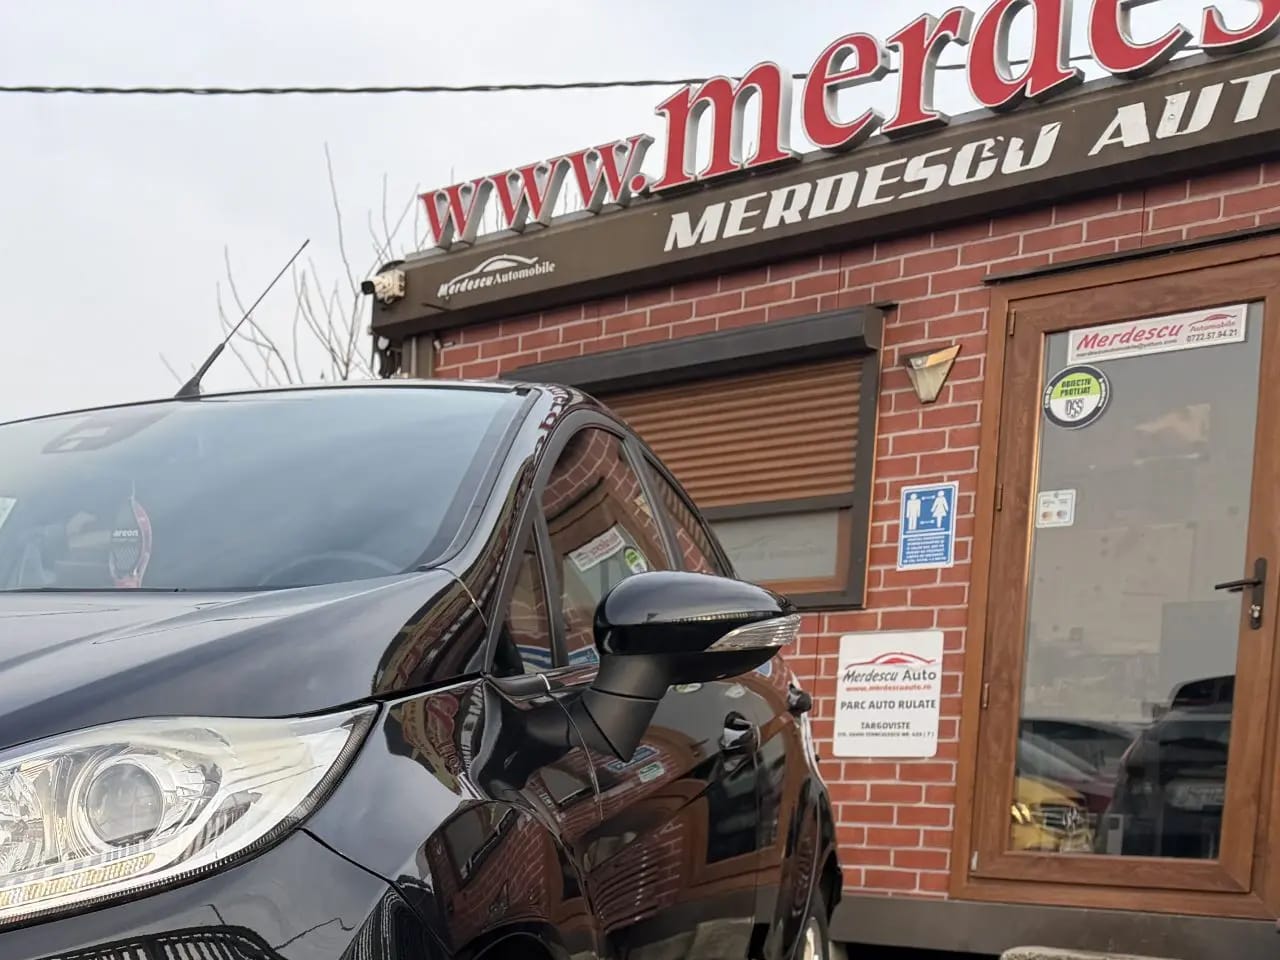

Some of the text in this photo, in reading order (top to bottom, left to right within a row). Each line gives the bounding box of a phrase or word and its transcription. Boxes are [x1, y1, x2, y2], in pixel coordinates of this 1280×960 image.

[663, 121, 1062, 252] MERDESCU
[1076, 323, 1184, 351] Merdescu
[842, 669, 937, 683] Merdescu Auto
[840, 699, 936, 711] PARC AUTO RULATE
